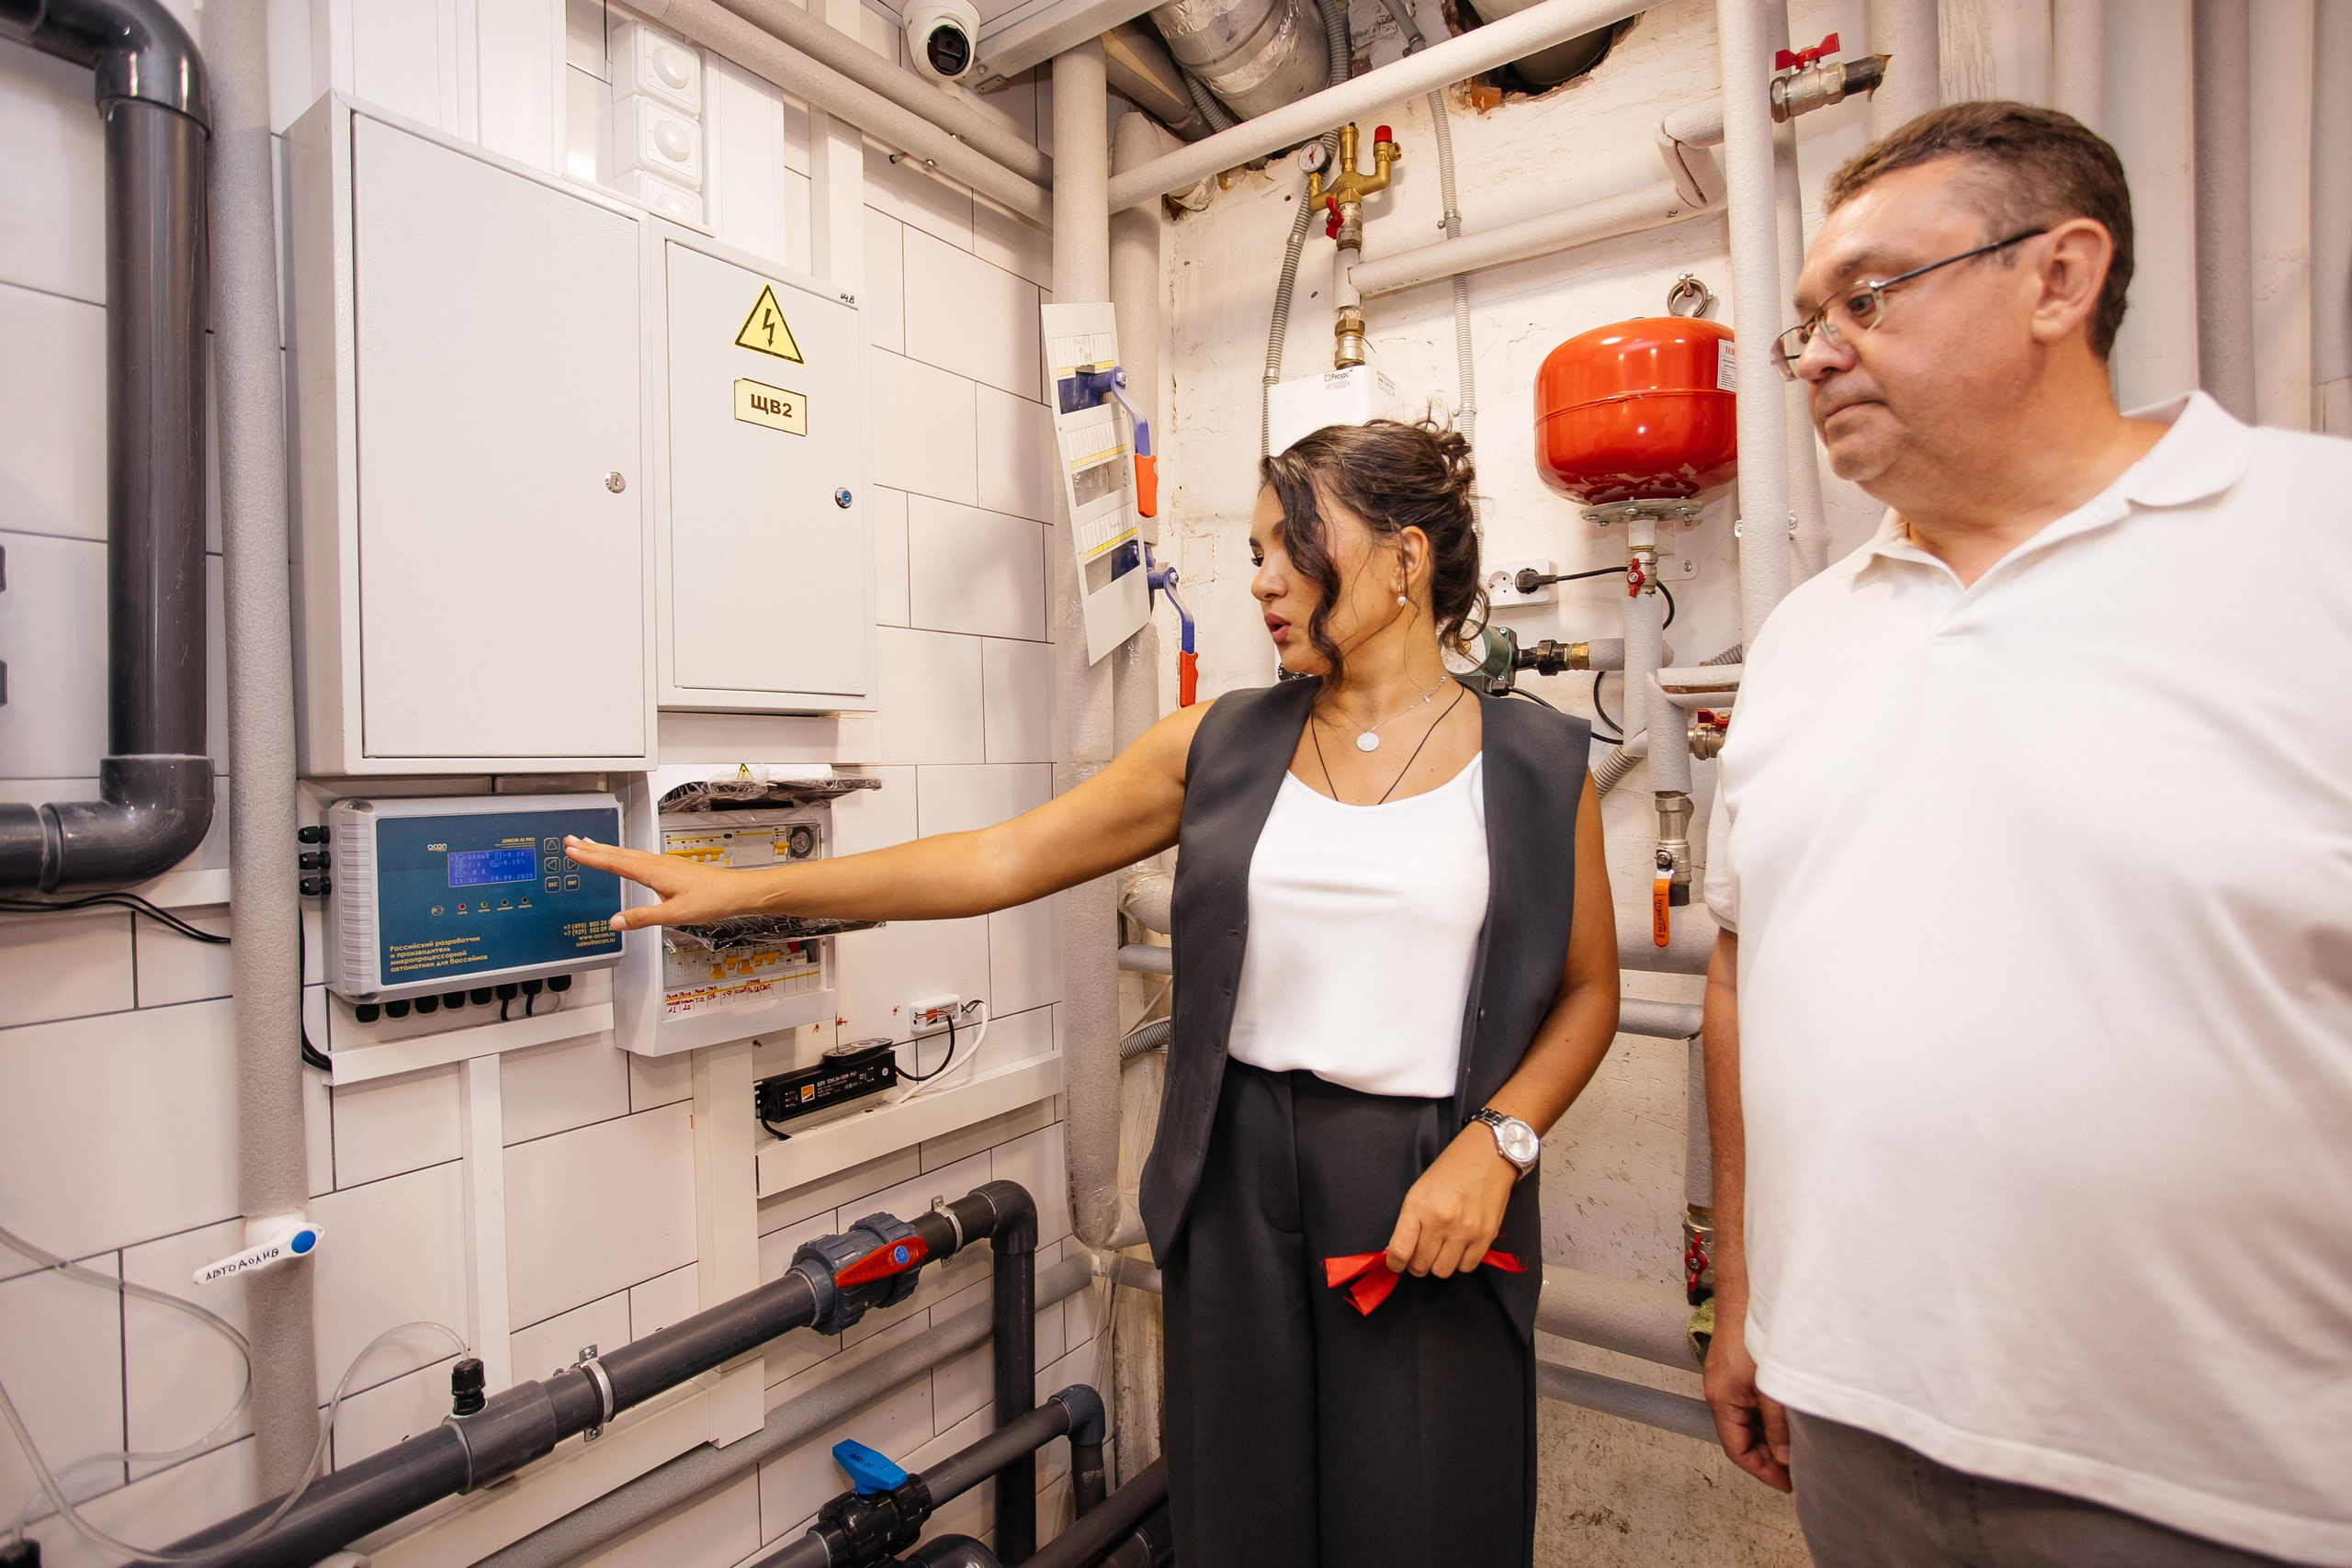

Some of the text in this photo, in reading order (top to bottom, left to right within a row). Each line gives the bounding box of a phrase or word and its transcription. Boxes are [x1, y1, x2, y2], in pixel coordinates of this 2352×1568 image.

[751, 393, 793, 419] ЩВ2
[426, 842, 447, 851] acon
[575, 938, 616, 947] sales@acon.ru
[579, 931, 616, 941] www.acon.ru
[390, 936, 481, 952] Российский разработчик
[390, 950, 467, 965] микропроцессорной
[396, 947, 451, 959] производитель
[390, 962, 435, 973] автоматики
[449, 954, 488, 964] бассейнов
[205, 1247, 279, 1282] АВТОДОЛИВ
